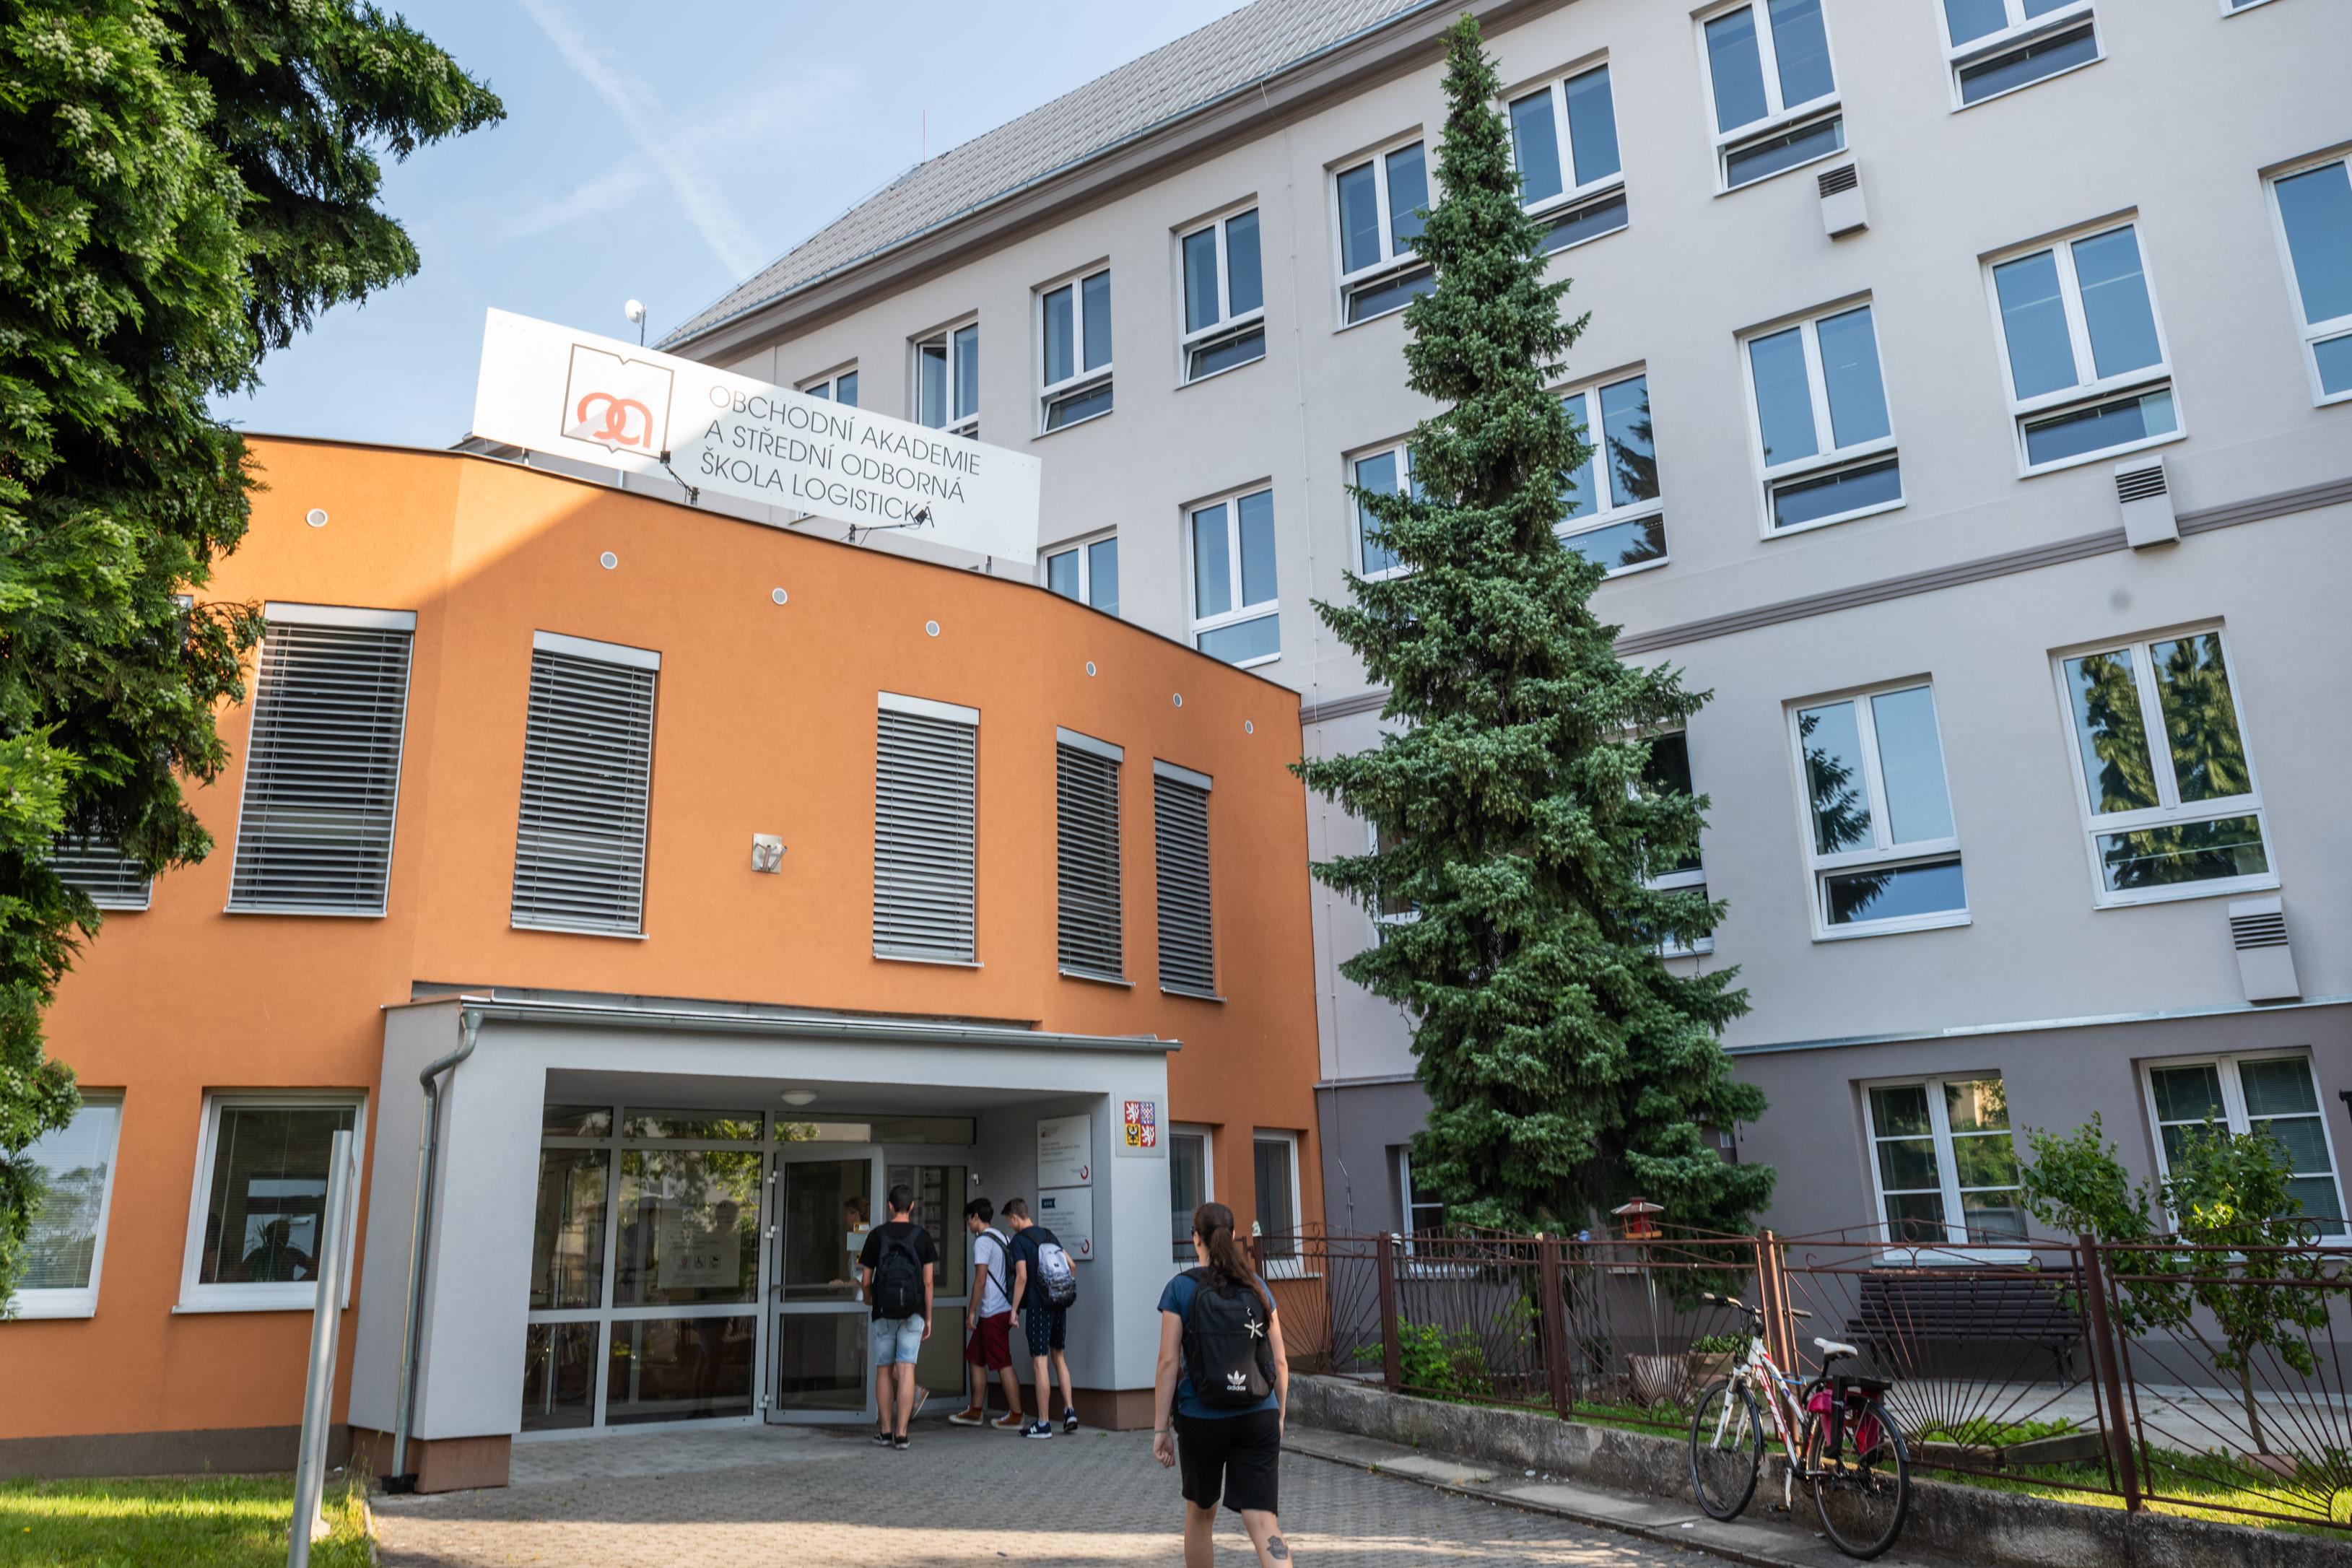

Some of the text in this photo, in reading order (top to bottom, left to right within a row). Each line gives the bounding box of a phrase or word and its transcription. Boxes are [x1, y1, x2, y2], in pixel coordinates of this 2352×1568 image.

[705, 419, 964, 503] A STŘEDNÍ ODBORNÁ
[710, 386, 980, 475] OBCHODNÍ AKADEMIE
[701, 446, 934, 528] ŠKOLA LOGISTICKÁ
